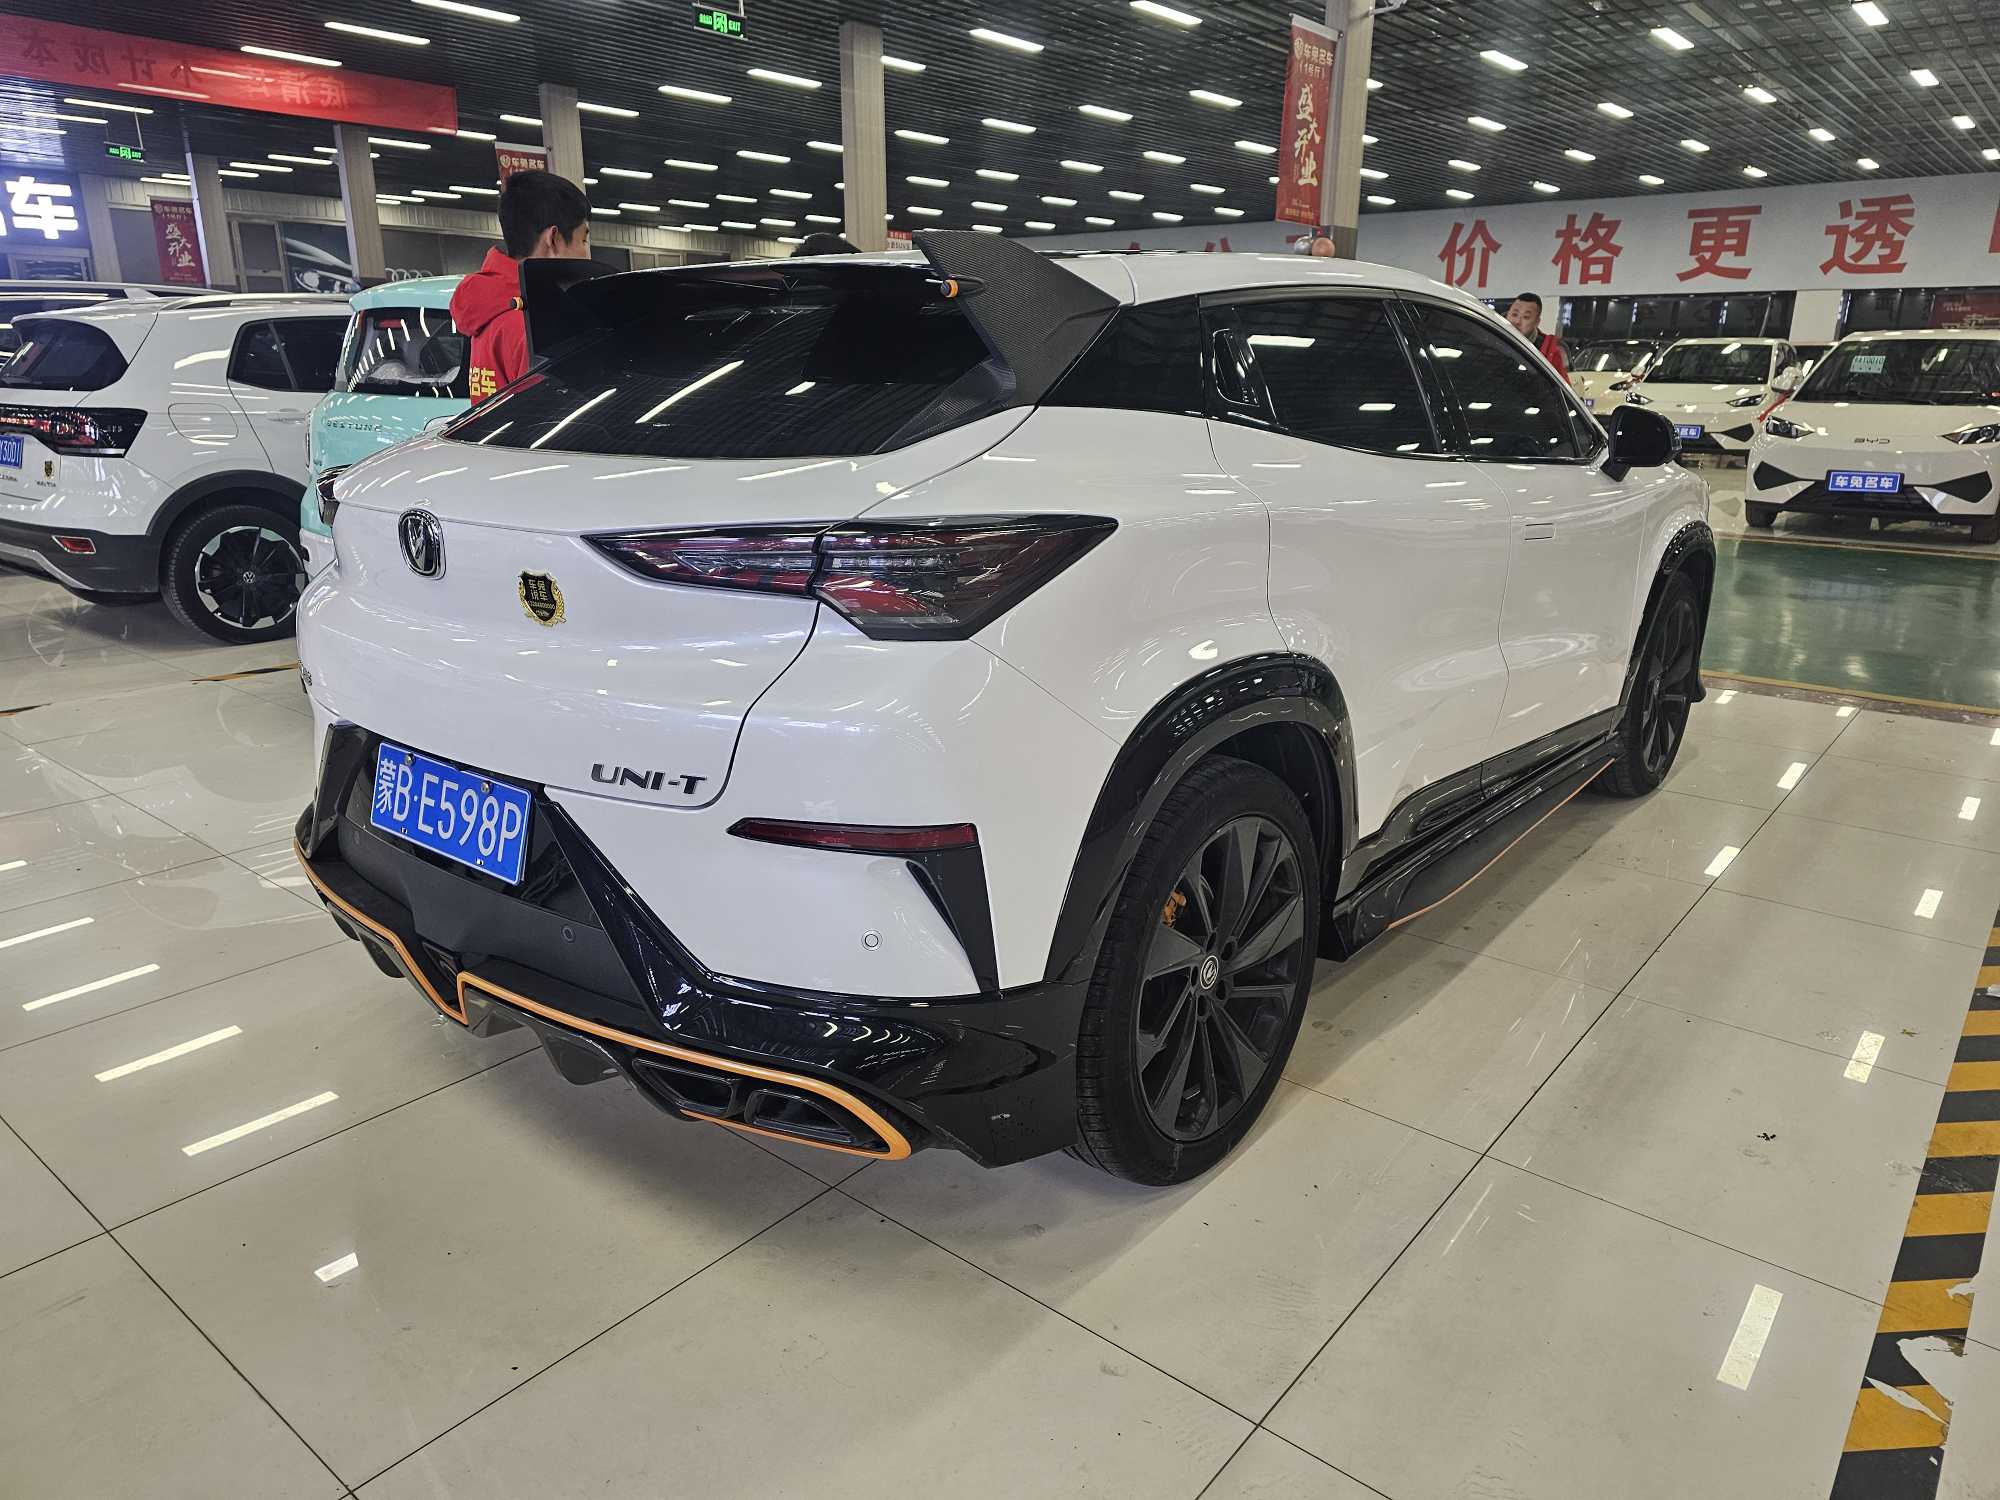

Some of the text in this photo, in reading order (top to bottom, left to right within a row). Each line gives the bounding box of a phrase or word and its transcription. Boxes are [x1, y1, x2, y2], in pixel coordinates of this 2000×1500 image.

[1294, 83, 1321, 187] 盛大开业
[0, 175, 79, 240] 车
[1854, 437, 1891, 445] BYD
[591, 763, 708, 795] UNI-T
